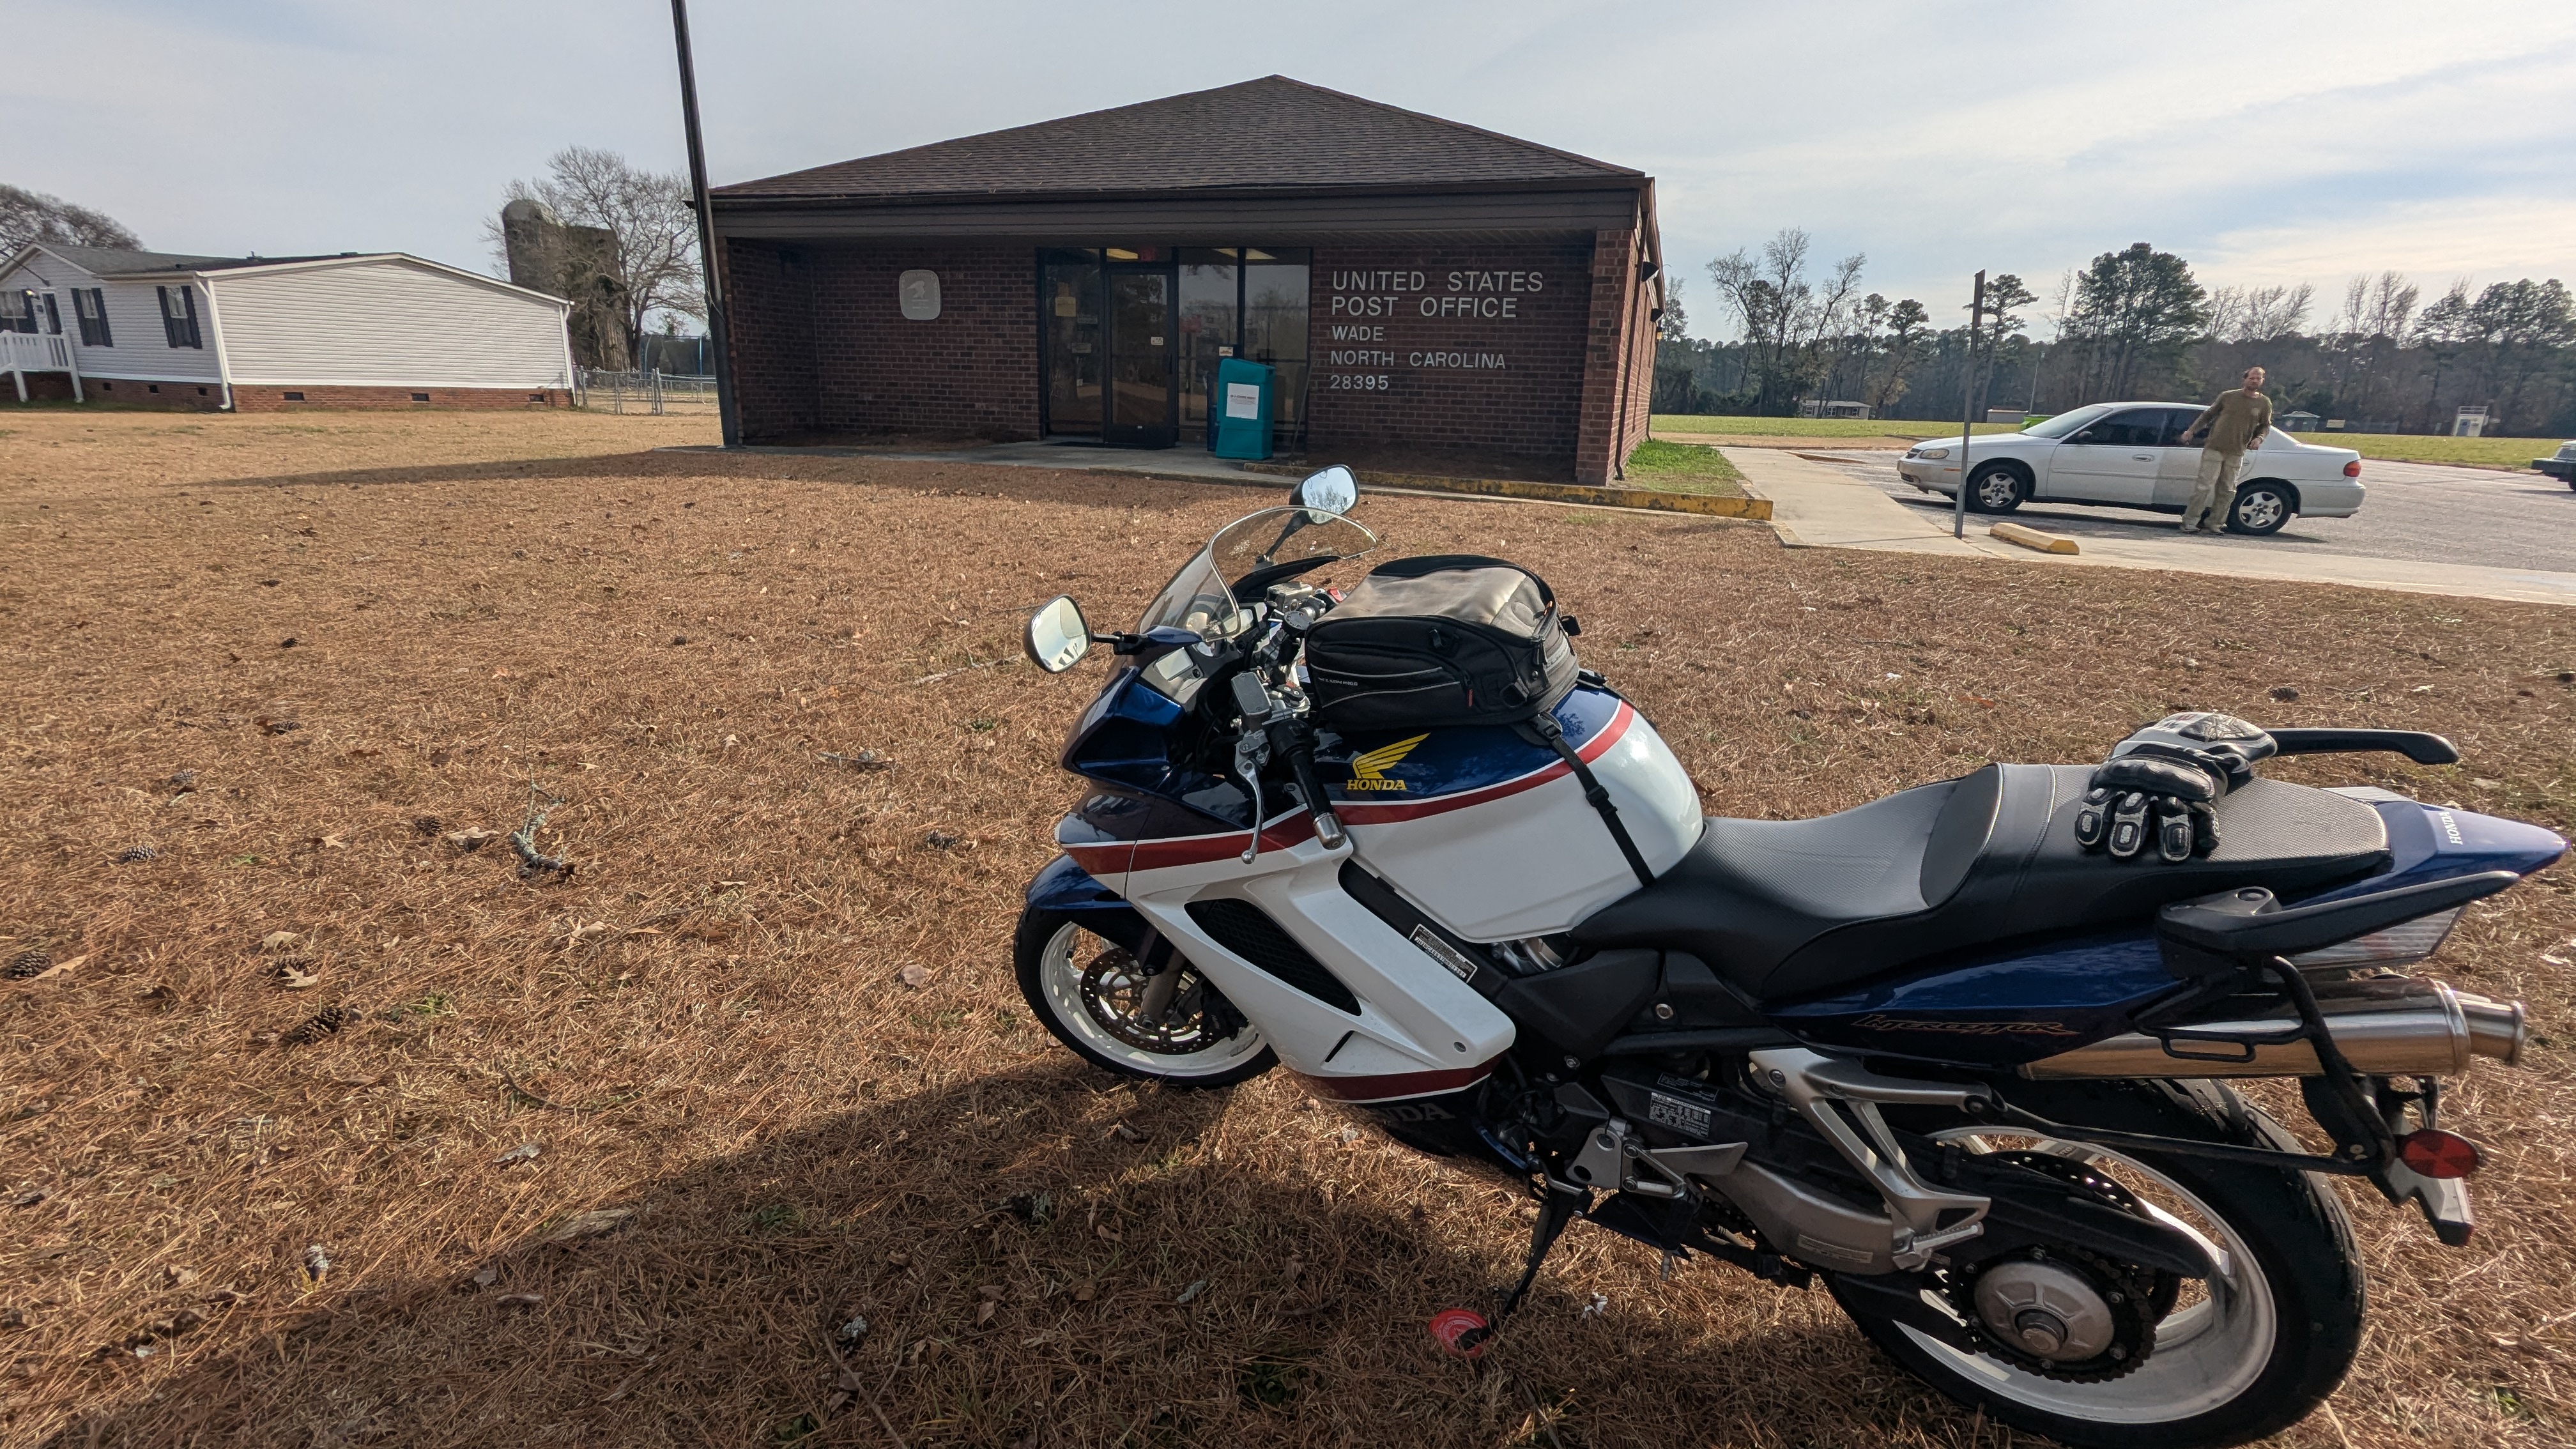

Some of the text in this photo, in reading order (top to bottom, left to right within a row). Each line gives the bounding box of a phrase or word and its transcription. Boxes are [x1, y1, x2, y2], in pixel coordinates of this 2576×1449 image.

[1333, 270, 1544, 292] UNITED STATES
[1331, 296, 1518, 318] POST OFFICE
[1331, 325, 1385, 342] WADE
[1330, 350, 1506, 369] NORTH CAROLINA
[1330, 374, 1389, 390] 28395
[1346, 778, 1408, 792] HONDA
[2438, 811, 2464, 845] HONDA
